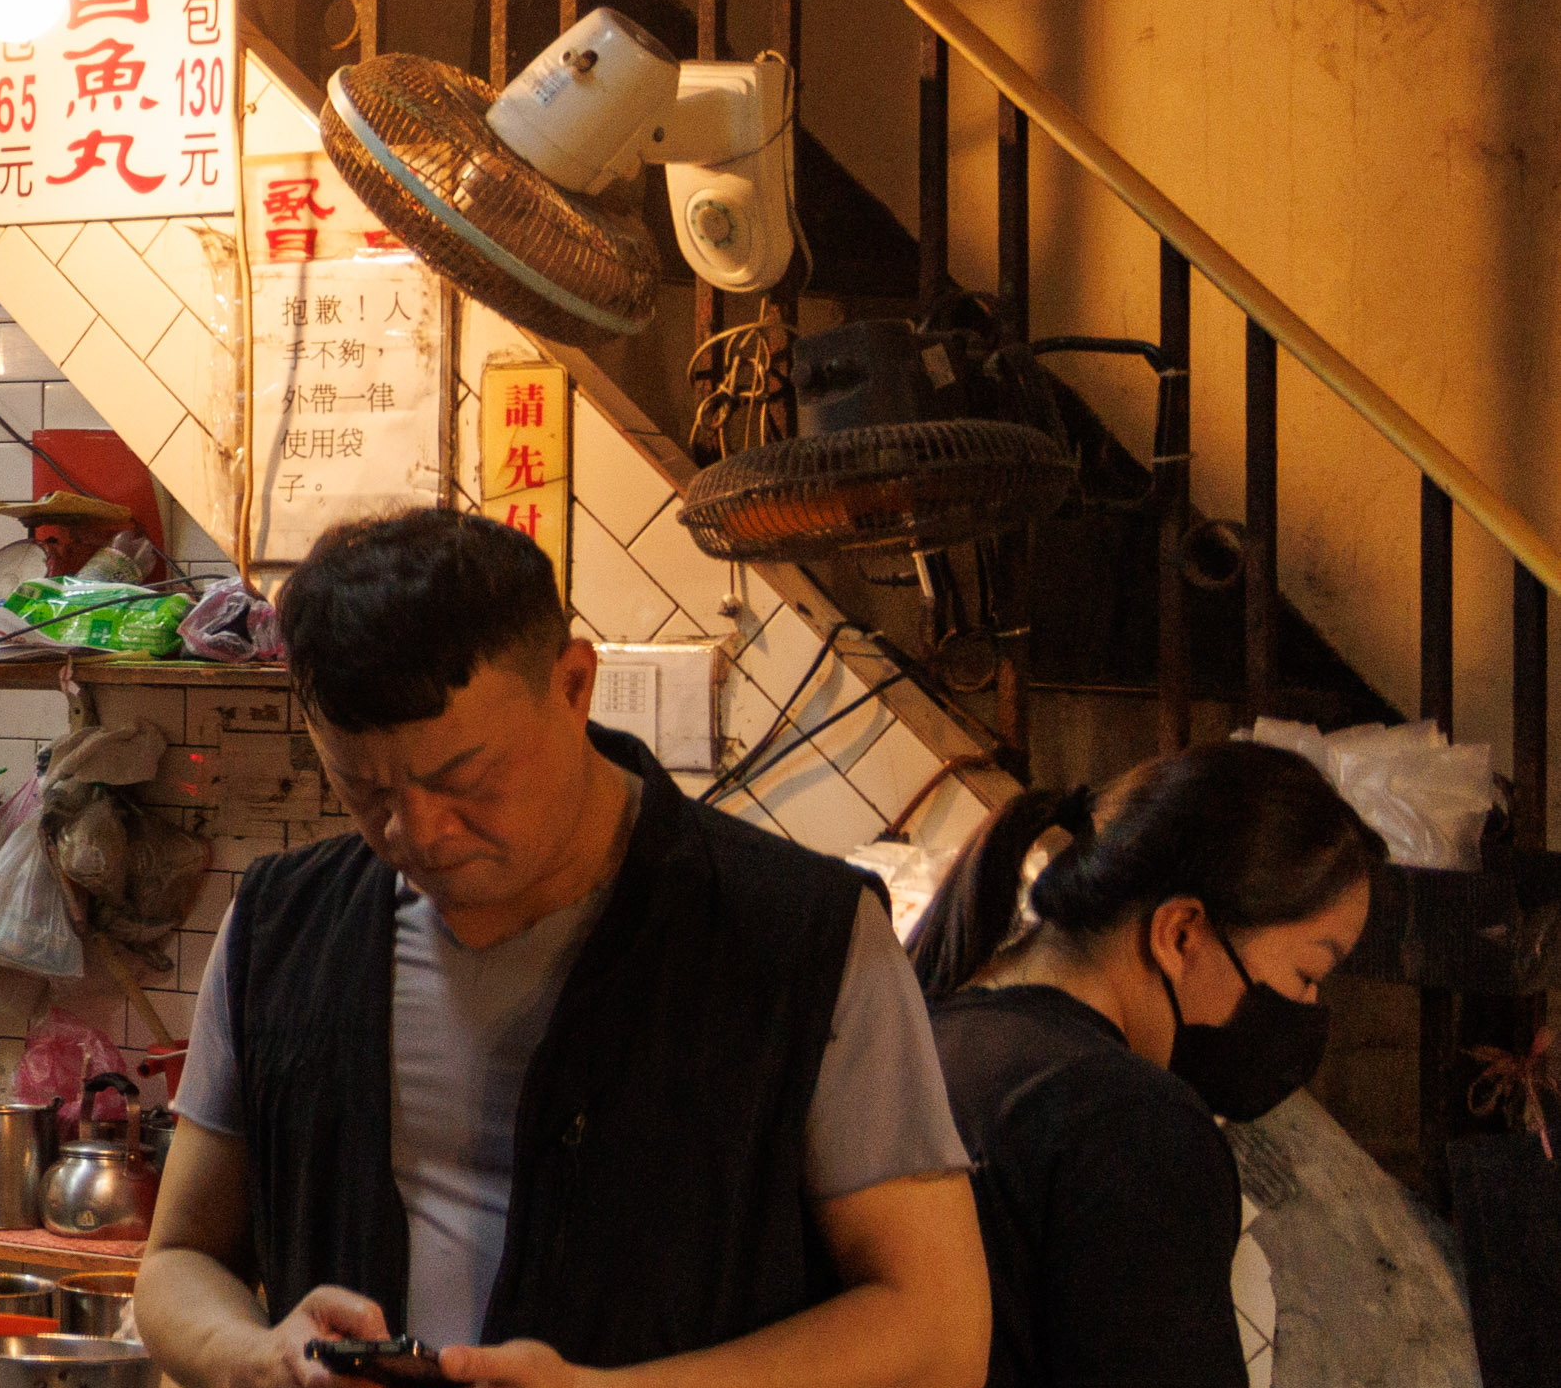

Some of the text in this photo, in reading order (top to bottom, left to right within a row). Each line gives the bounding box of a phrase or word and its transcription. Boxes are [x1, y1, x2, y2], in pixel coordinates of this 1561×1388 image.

[281, 382, 395, 416] 外帶一律
[280, 428, 364, 460] 使用袋
